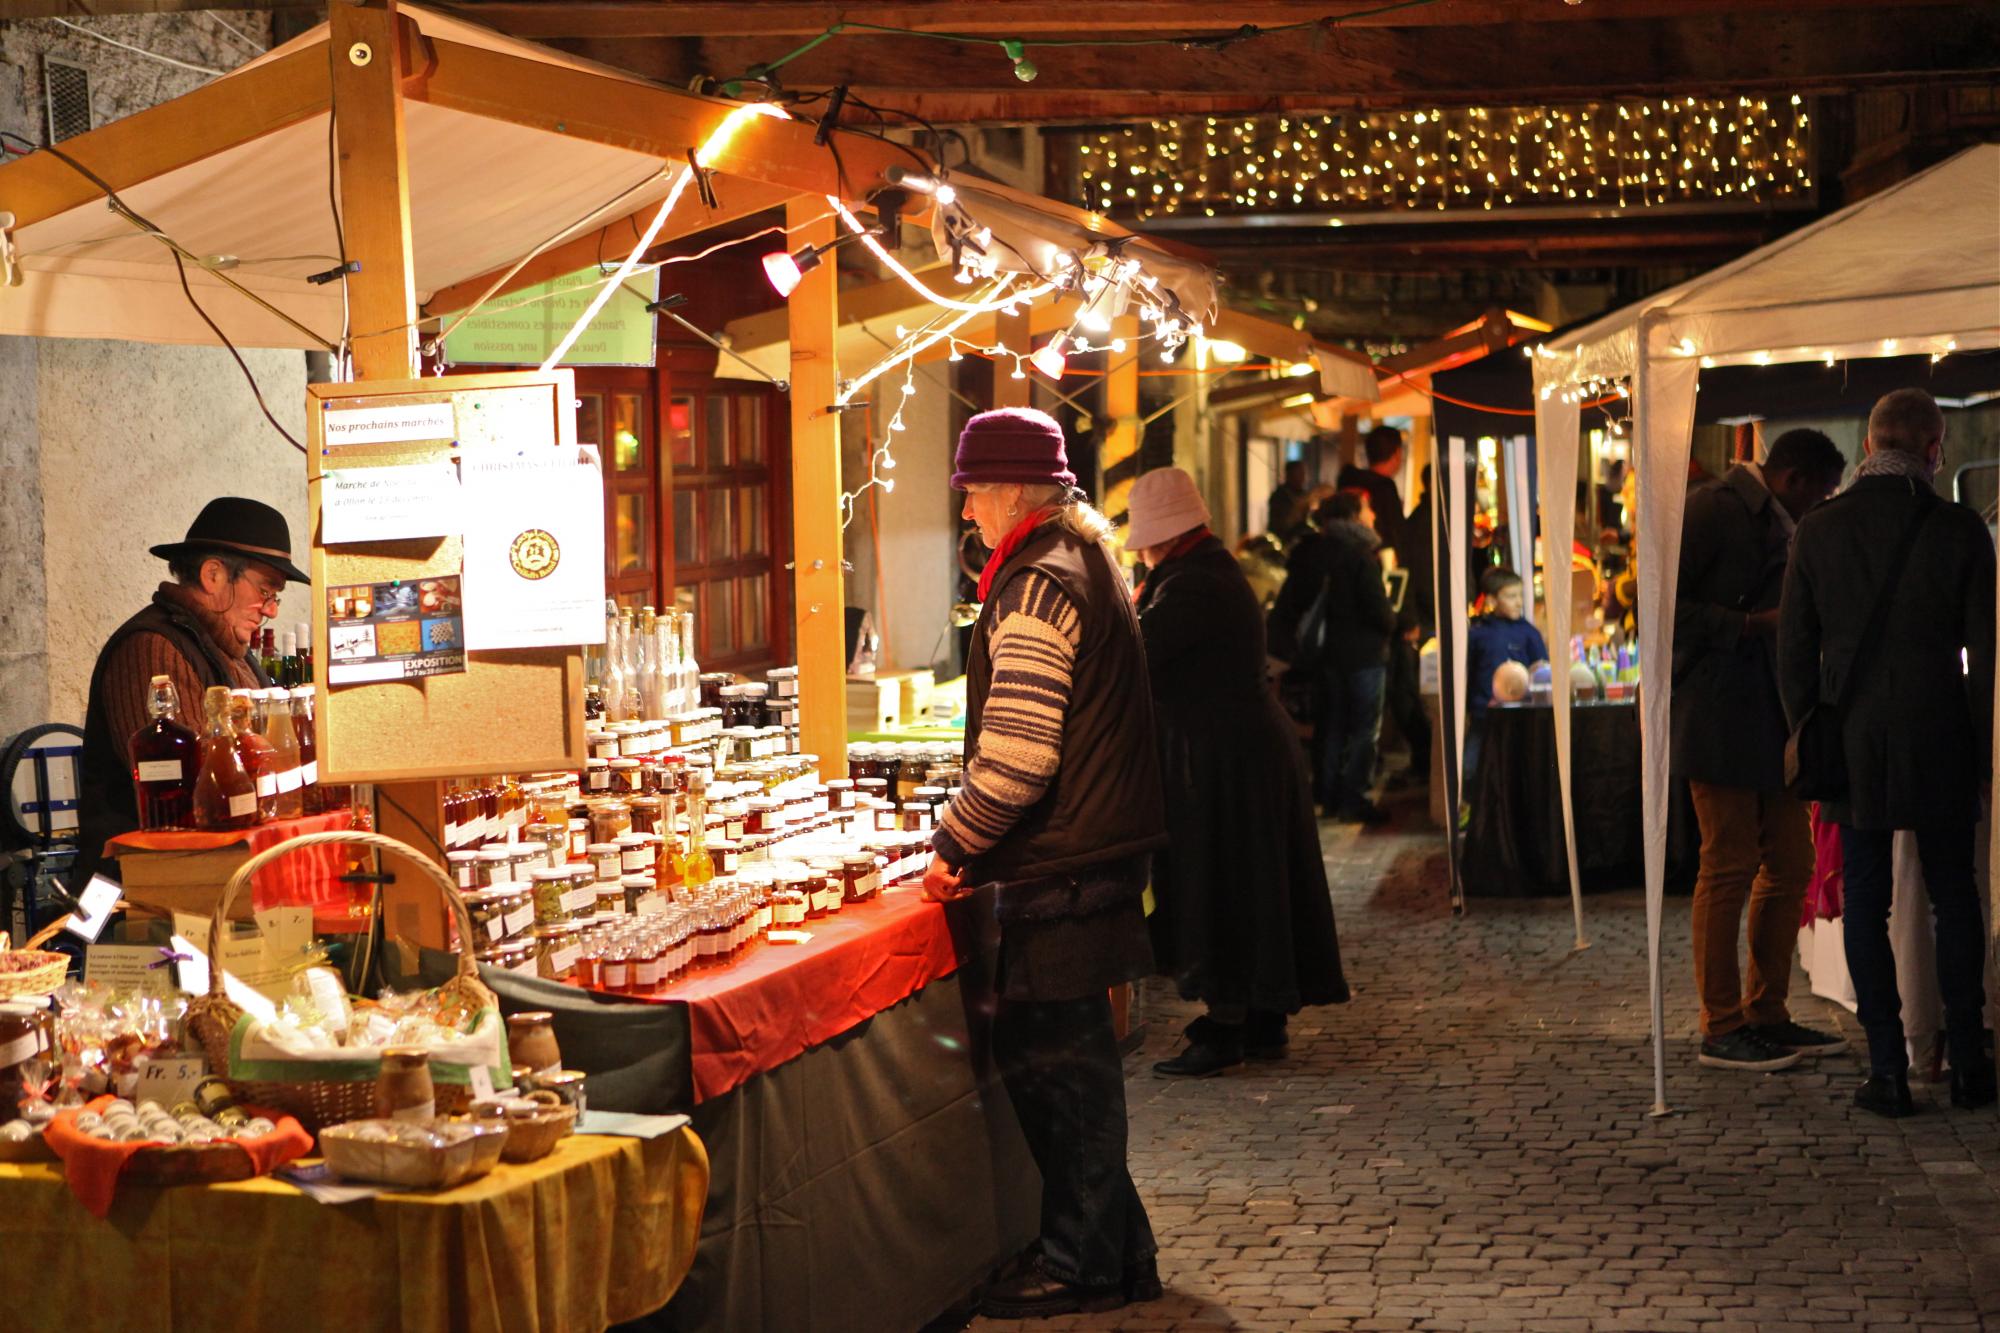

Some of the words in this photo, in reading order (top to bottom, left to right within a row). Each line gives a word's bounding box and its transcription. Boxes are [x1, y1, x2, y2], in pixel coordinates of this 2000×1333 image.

[327, 422, 347, 433] Nos
[348, 420, 399, 434] prochains
[404, 655, 462, 670] EXPOSITION
[146, 1064, 166, 1080] Fr.
